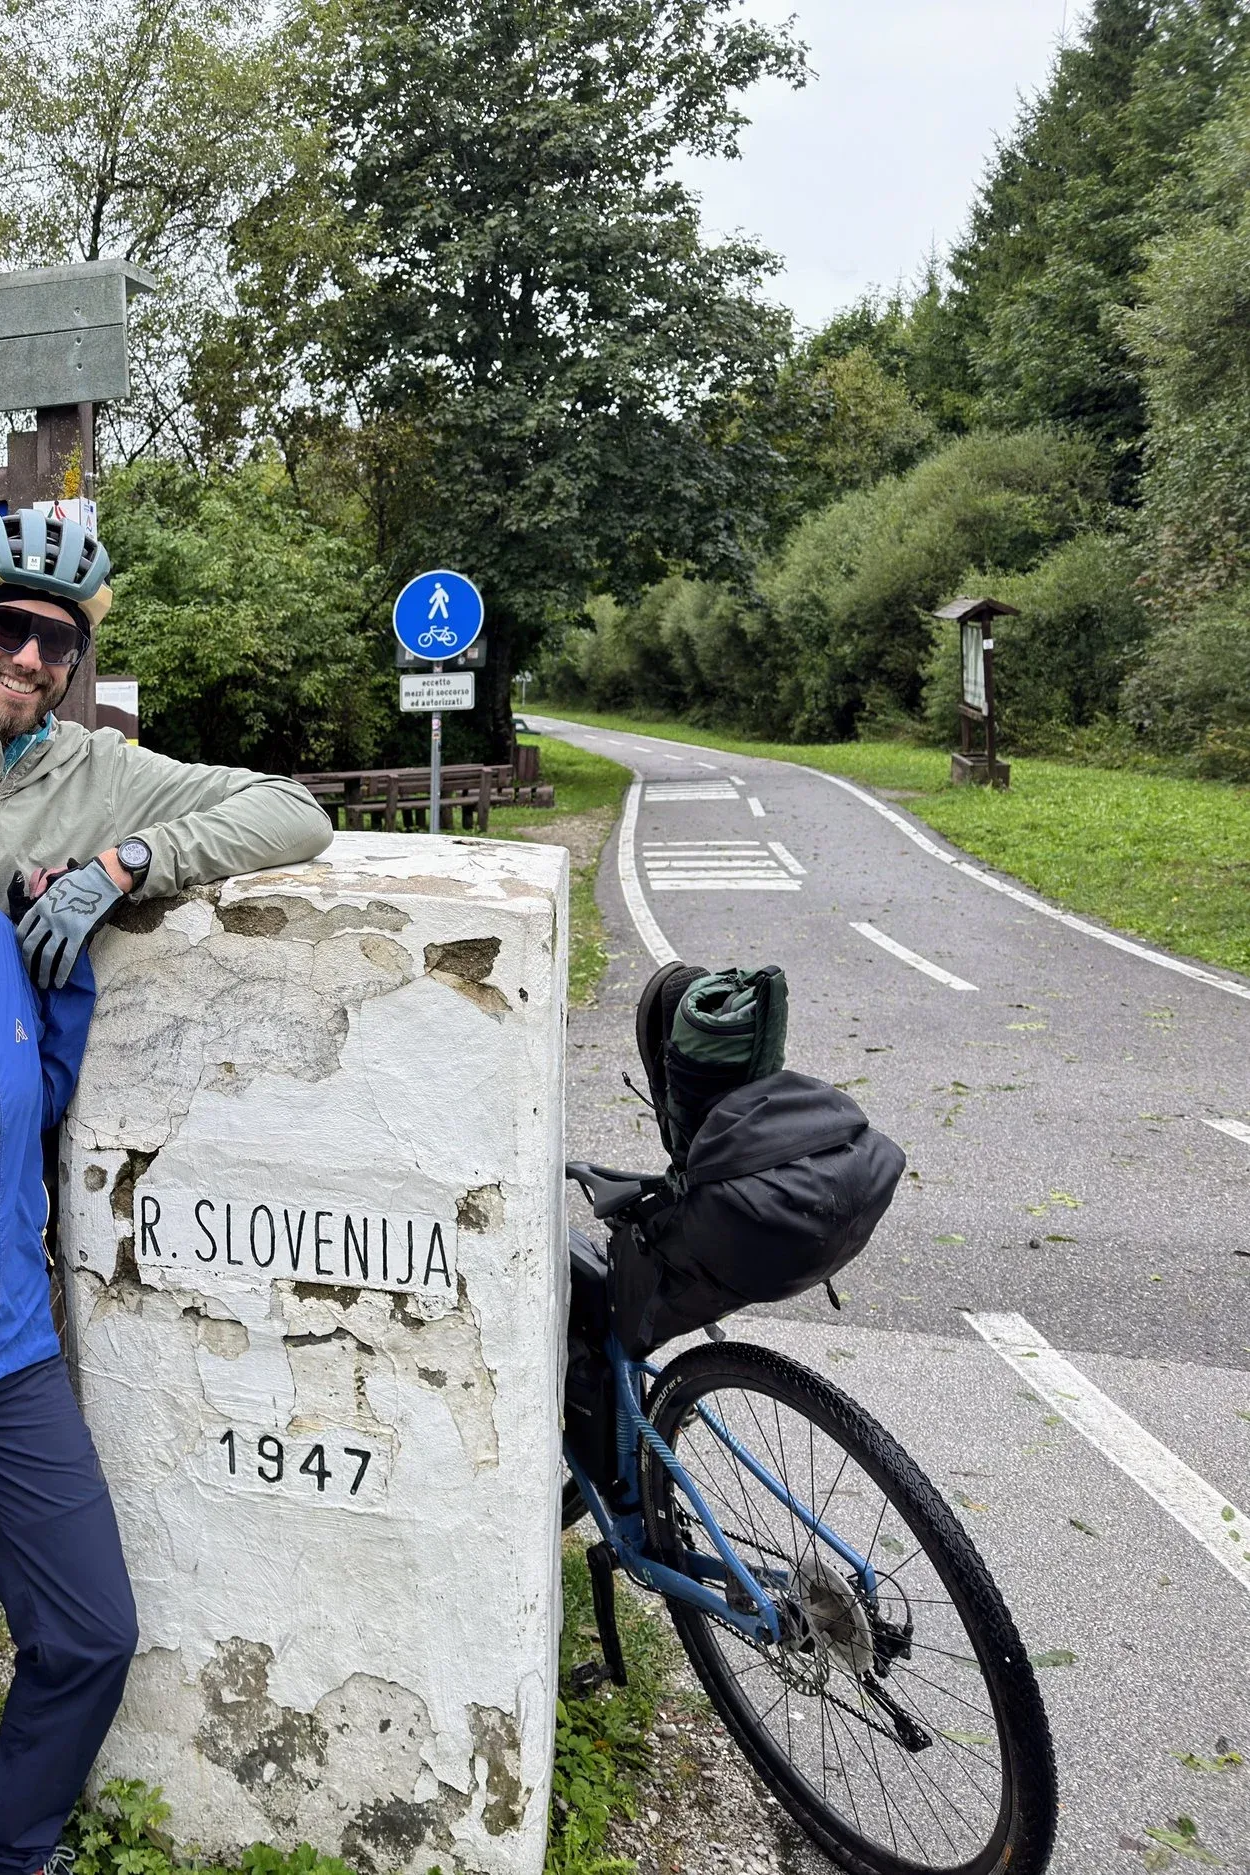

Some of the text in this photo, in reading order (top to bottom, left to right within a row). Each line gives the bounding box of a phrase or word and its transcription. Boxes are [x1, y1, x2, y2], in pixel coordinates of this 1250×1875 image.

[422, 678, 450, 686] eccetto
[404, 688, 470, 697] mezzi di soccorso
[410, 698, 463, 707] ed autorizzati
[140, 1195, 452, 1288] R. SLOVENIJA
[219, 1429, 372, 1496] 1947
